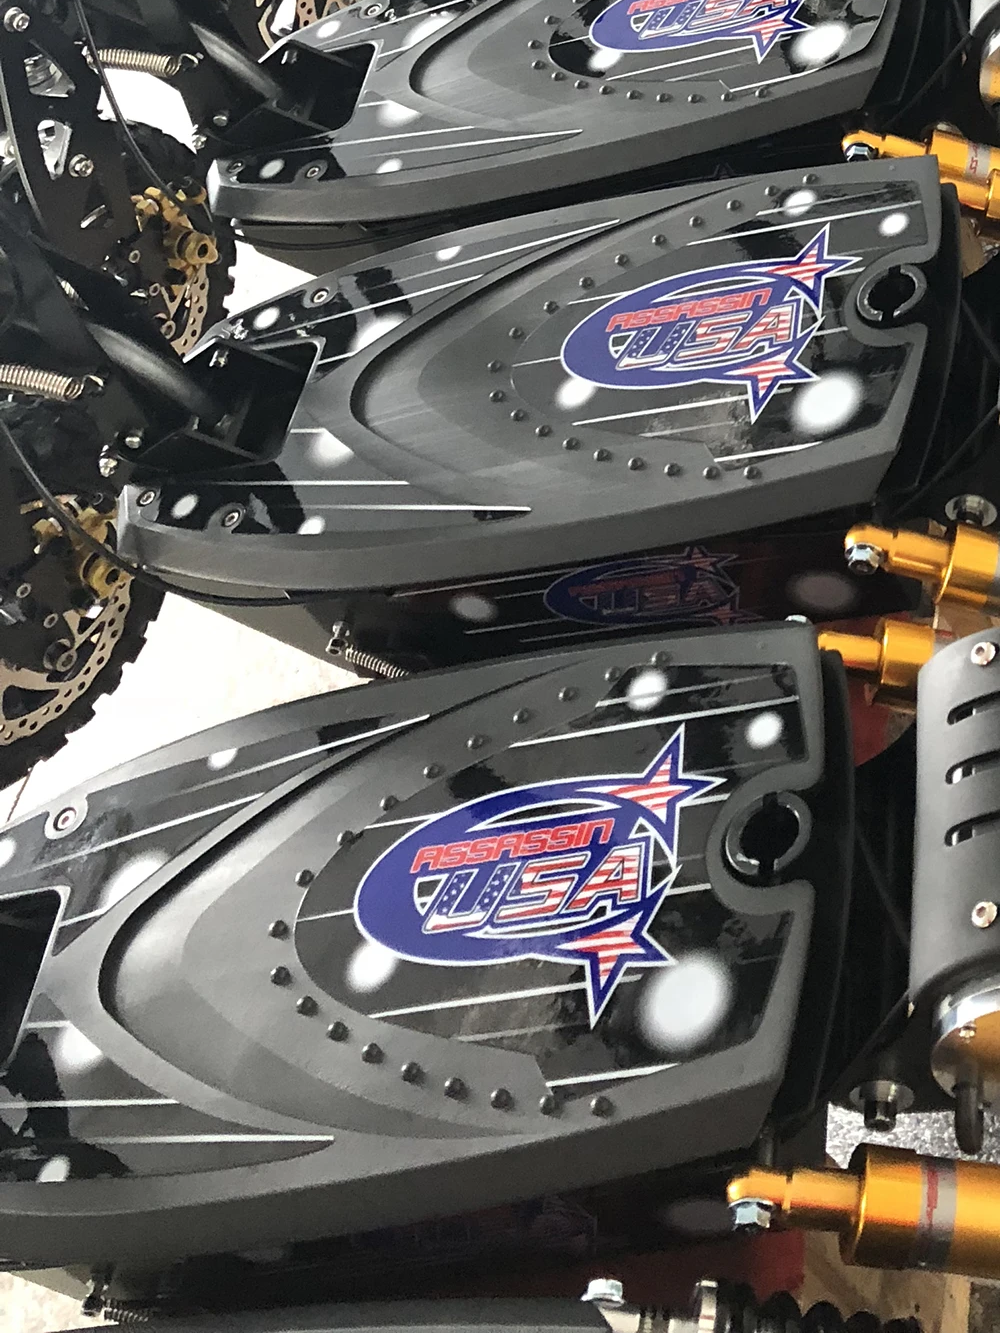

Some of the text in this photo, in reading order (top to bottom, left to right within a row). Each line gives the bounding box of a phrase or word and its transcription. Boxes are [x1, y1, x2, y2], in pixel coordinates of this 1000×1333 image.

[606, 288, 771, 333] ASSASSIN
[615, 302, 795, 371] USA
[411, 819, 614, 873] ASSASSIN
[422, 841, 648, 935] USA
